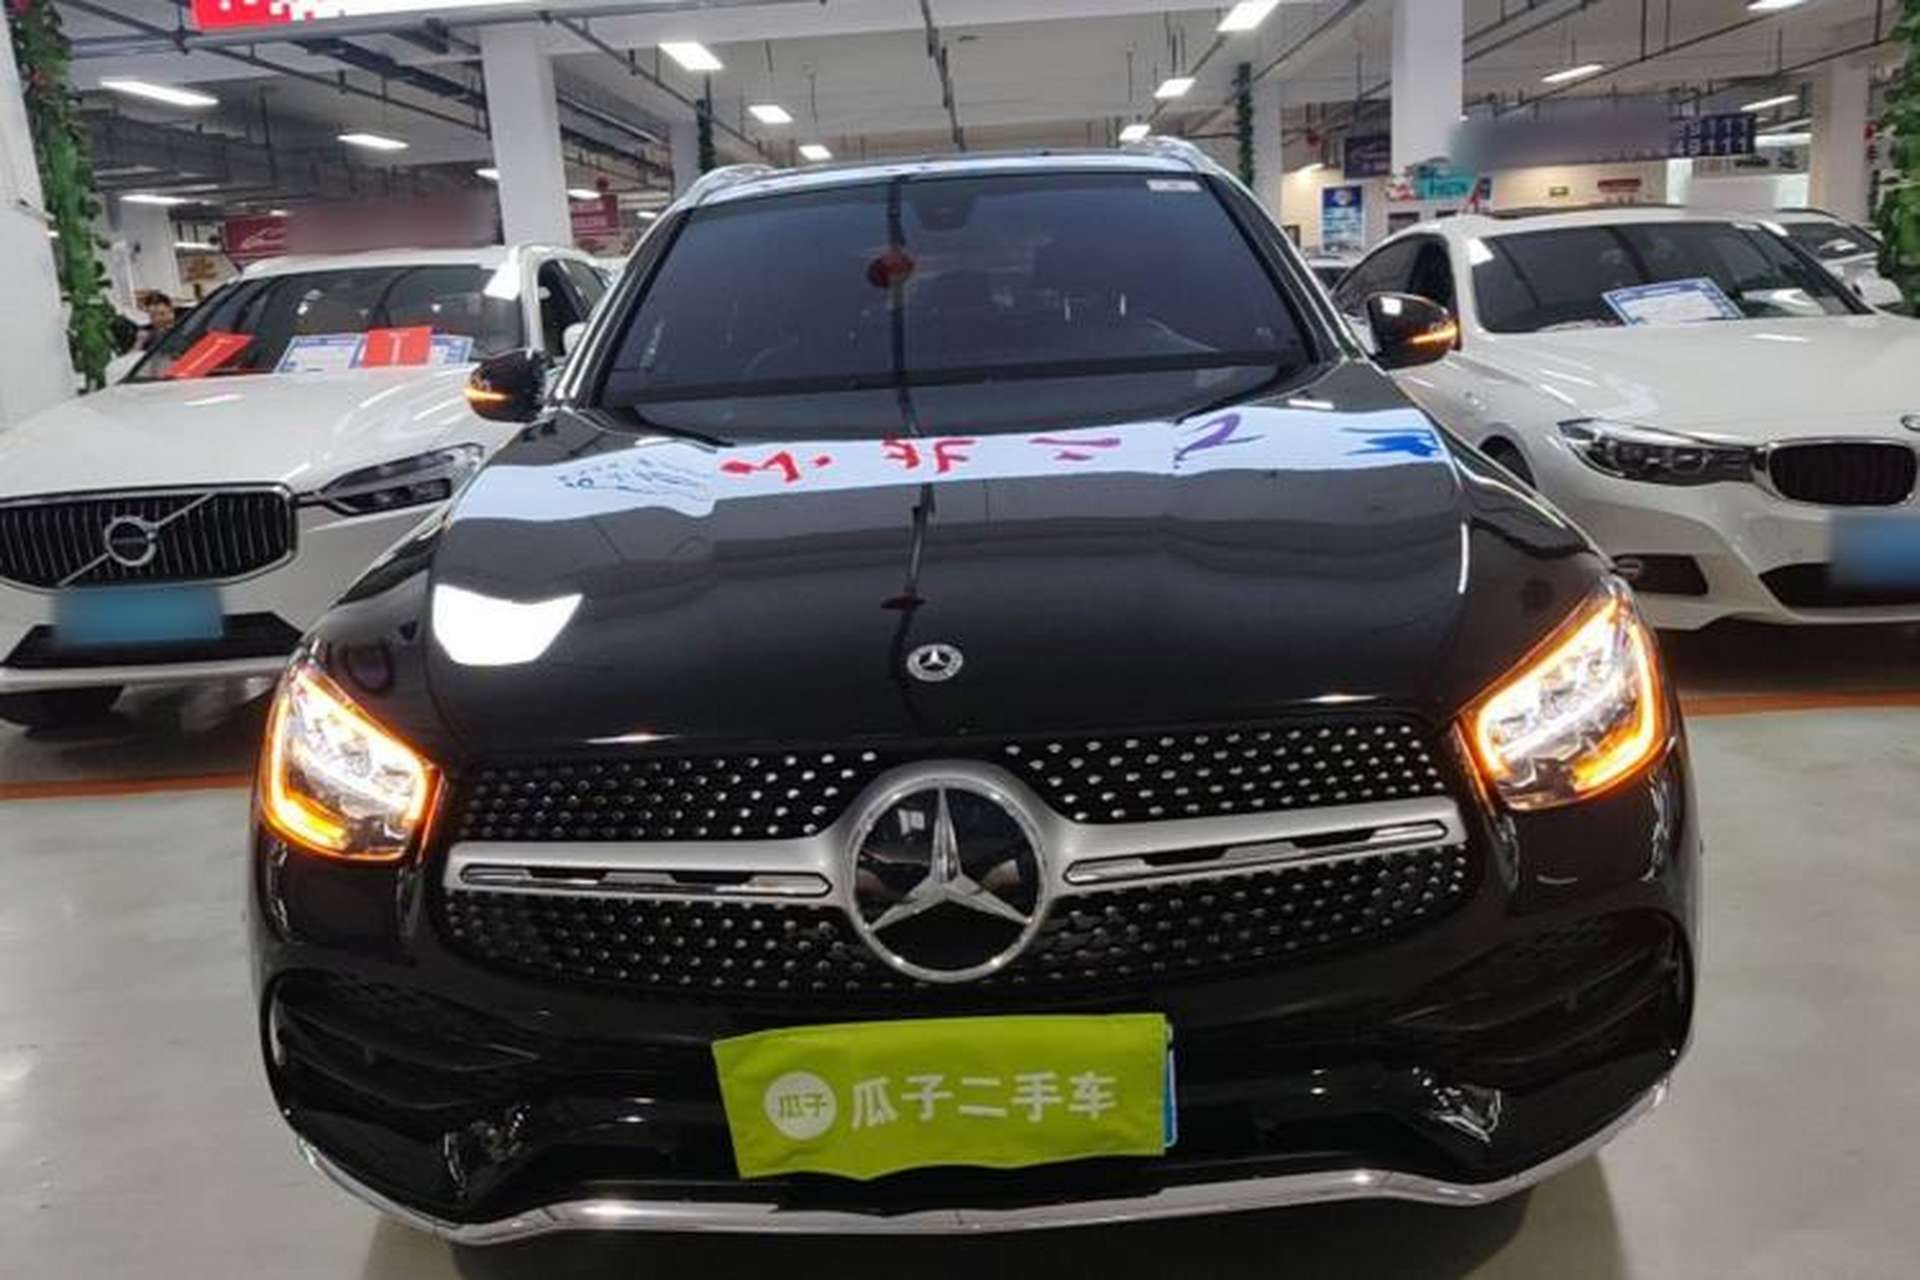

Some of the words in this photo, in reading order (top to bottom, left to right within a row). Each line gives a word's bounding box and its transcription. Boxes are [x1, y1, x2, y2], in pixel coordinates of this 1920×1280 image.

[778, 1092, 829, 1120] 瓜子
[850, 1071, 1120, 1130] 瓜子二手车
